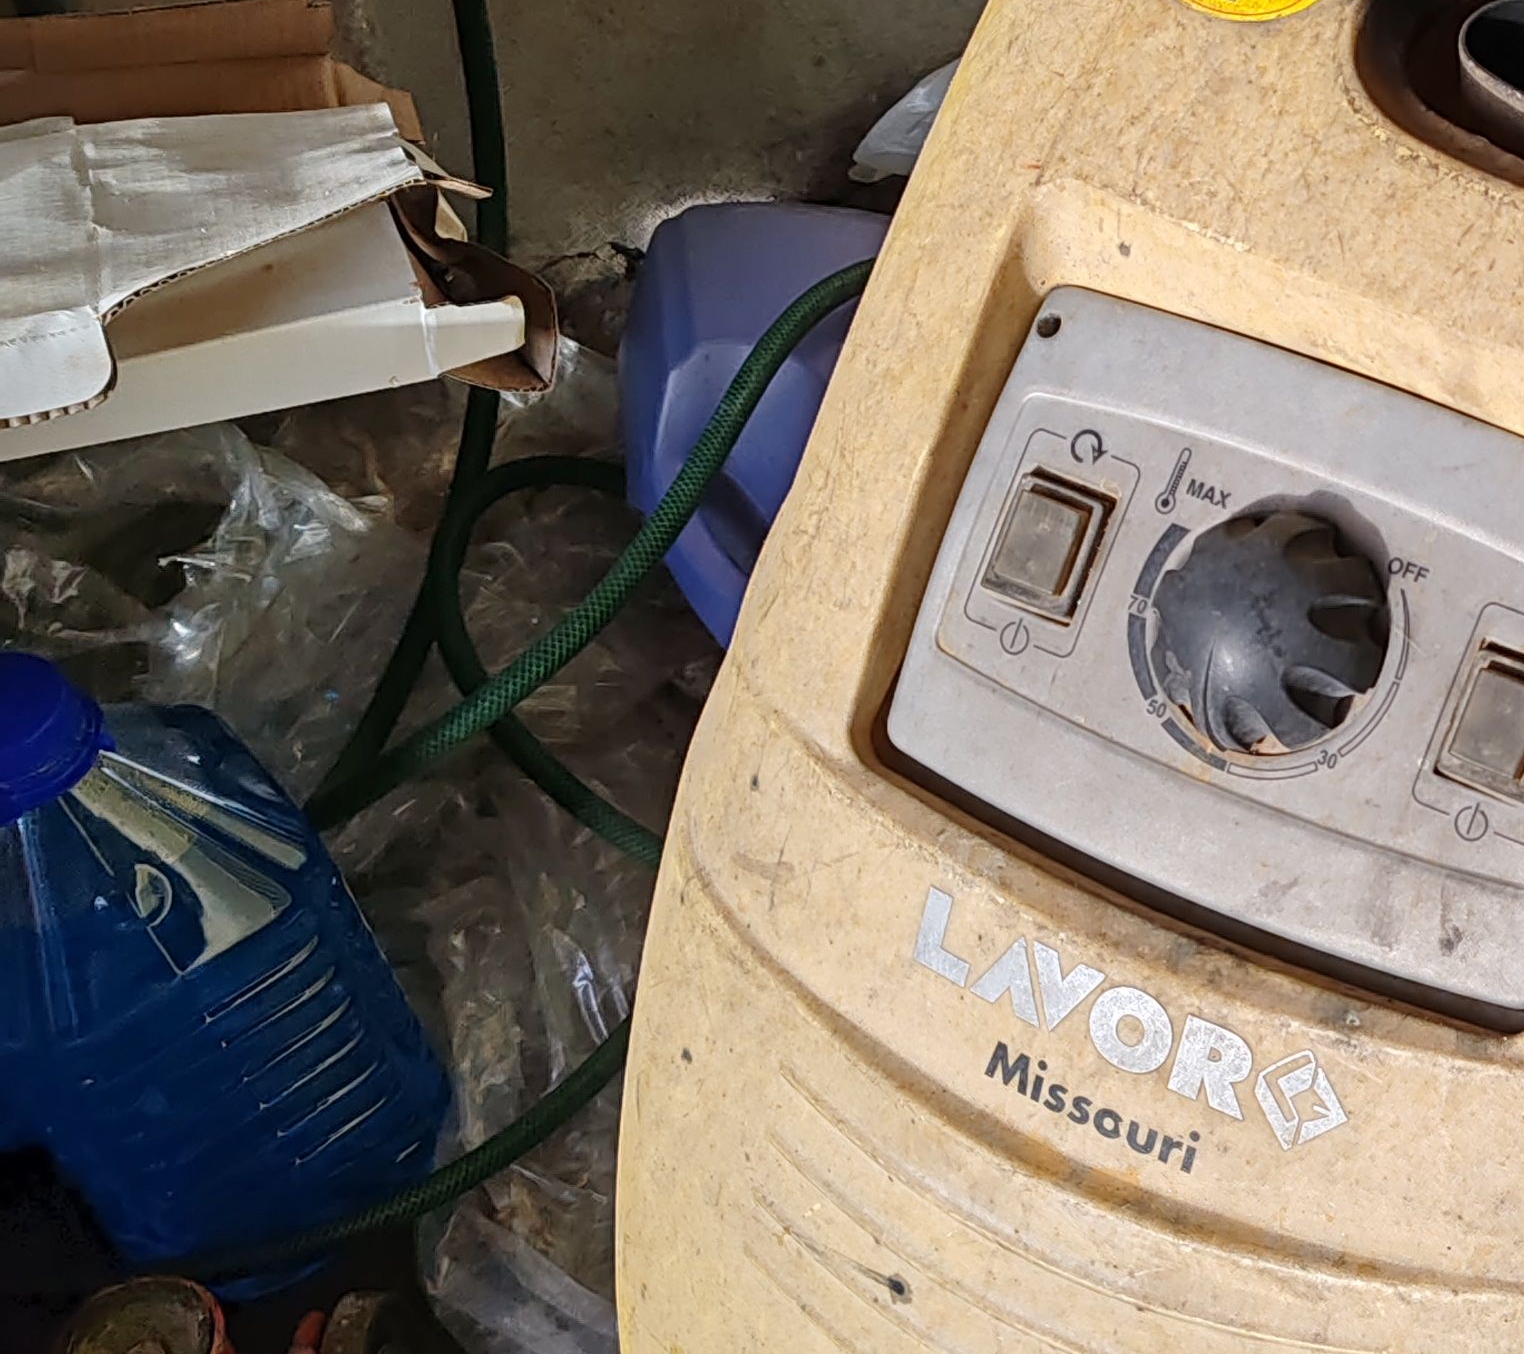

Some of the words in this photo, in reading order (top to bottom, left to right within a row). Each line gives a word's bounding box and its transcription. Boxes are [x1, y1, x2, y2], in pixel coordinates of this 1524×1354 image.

[1187, 479, 1232, 509] MAX
[1388, 557, 1430, 583] OFF
[1128, 596, 1148, 615] 70
[1146, 700, 1168, 718] 50
[1317, 749, 1339, 770] 30
[913, 885, 1254, 1121] LAVOR
[984, 1040, 1202, 1174] Missouri
